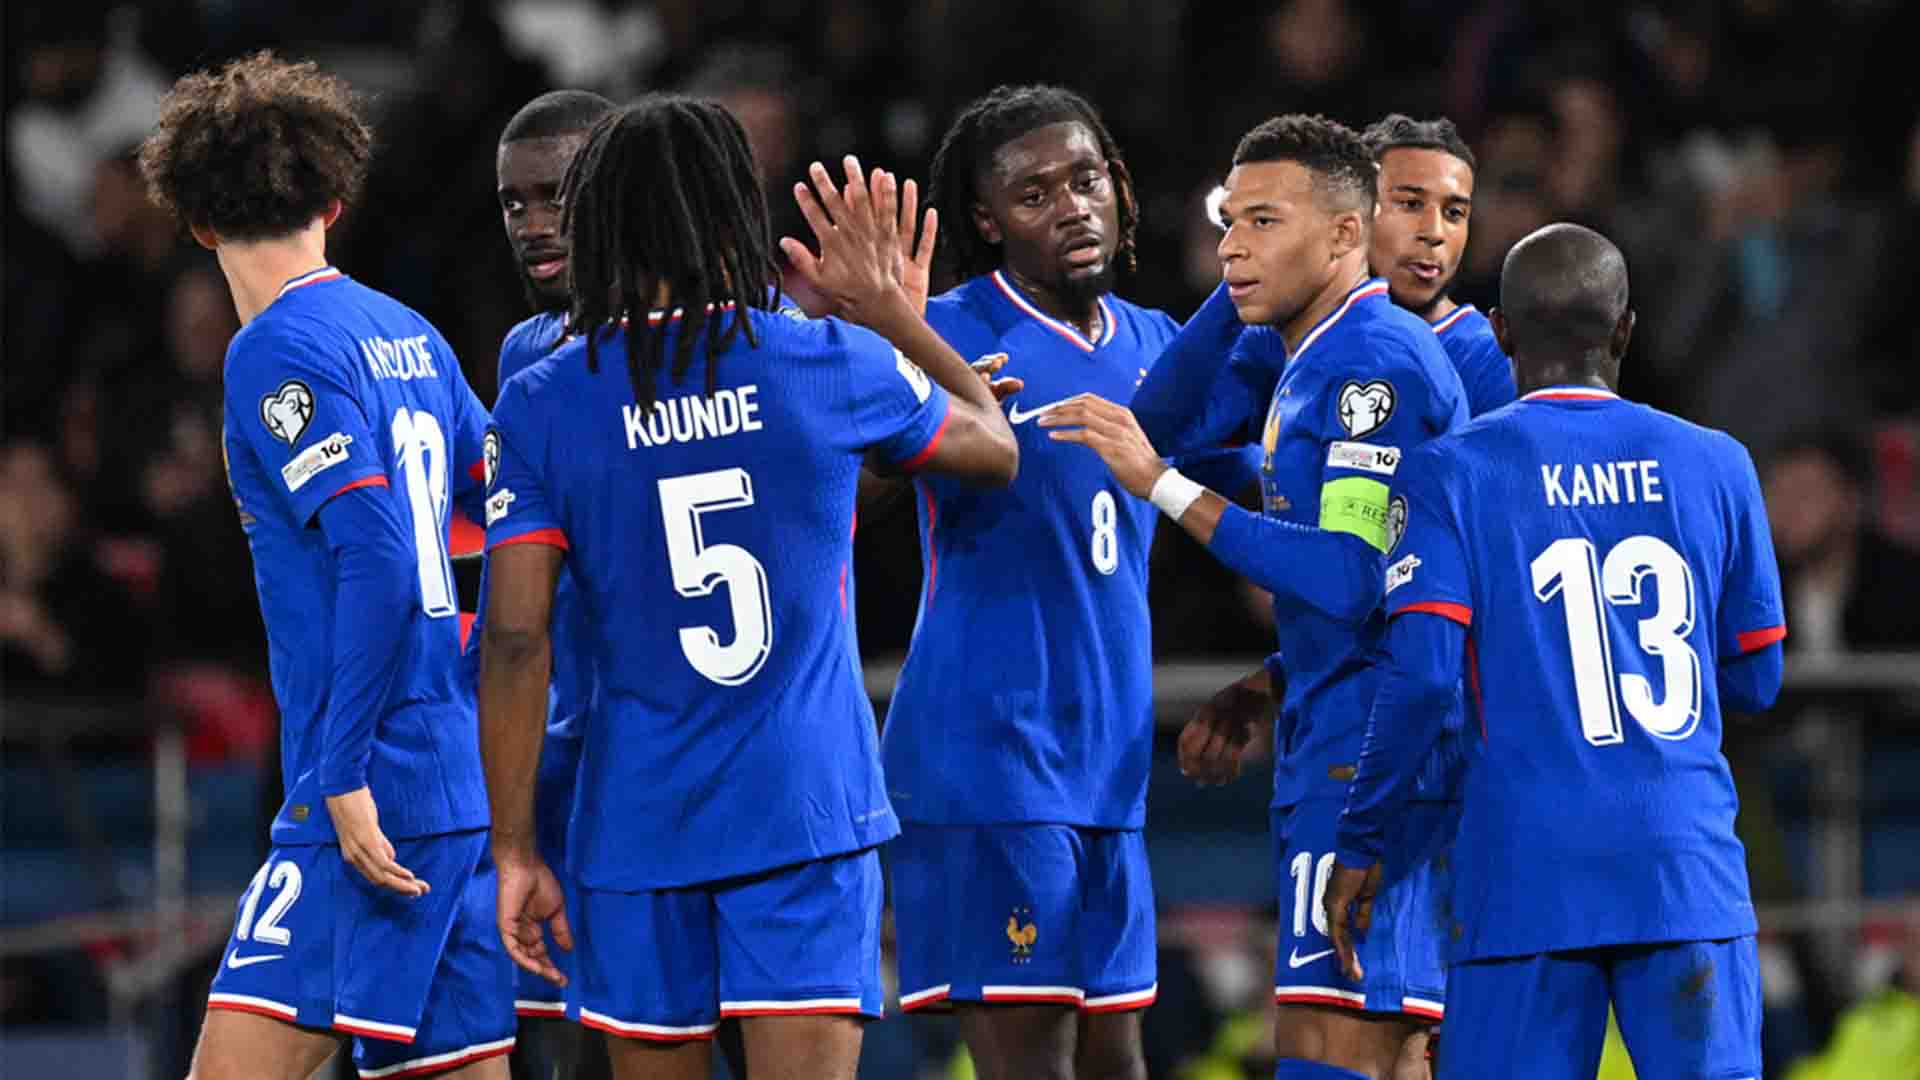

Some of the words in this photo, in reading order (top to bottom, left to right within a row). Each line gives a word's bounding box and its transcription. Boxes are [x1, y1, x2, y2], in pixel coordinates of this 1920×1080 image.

[622, 385, 763, 449] KOUNDE
[1376, 451, 1394, 466] 10
[1541, 460, 1663, 506] KANTE
[1091, 490, 1118, 575] 8
[657, 467, 773, 687] 5
[1530, 535, 1701, 746] 13
[236, 861, 302, 946] 12
